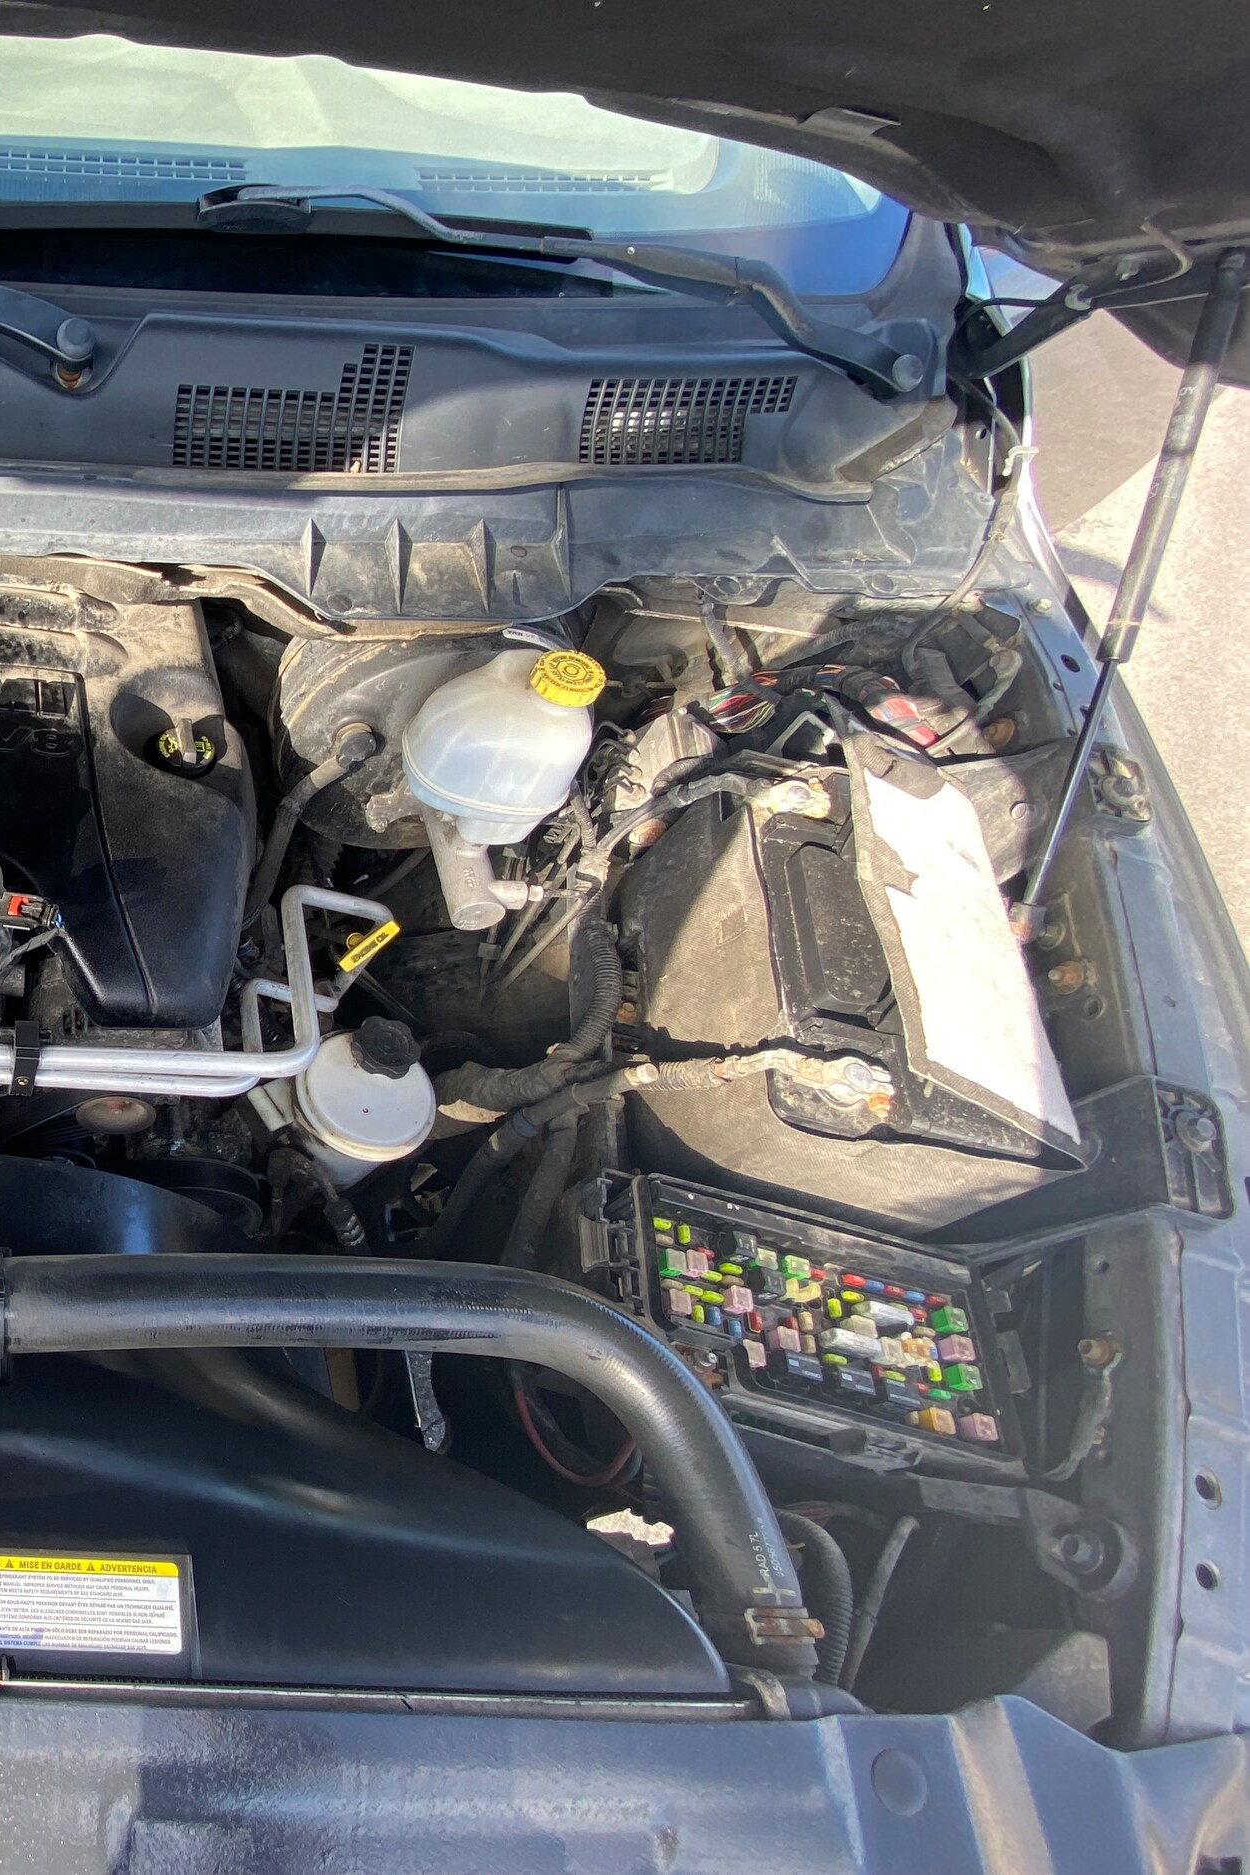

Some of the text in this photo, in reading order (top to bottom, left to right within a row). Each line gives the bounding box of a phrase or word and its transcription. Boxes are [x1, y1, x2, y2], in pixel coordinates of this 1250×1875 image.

[350, 932, 390, 964] ENGINE OIL
[19, 1560, 39, 1569] MISE
[42, 1561, 52, 1570] EN
[54, 1562, 82, 1571] GARDE
[100, 1564, 157, 1574] ADVERTENCIA
[755, 1554, 771, 1577] RAD
